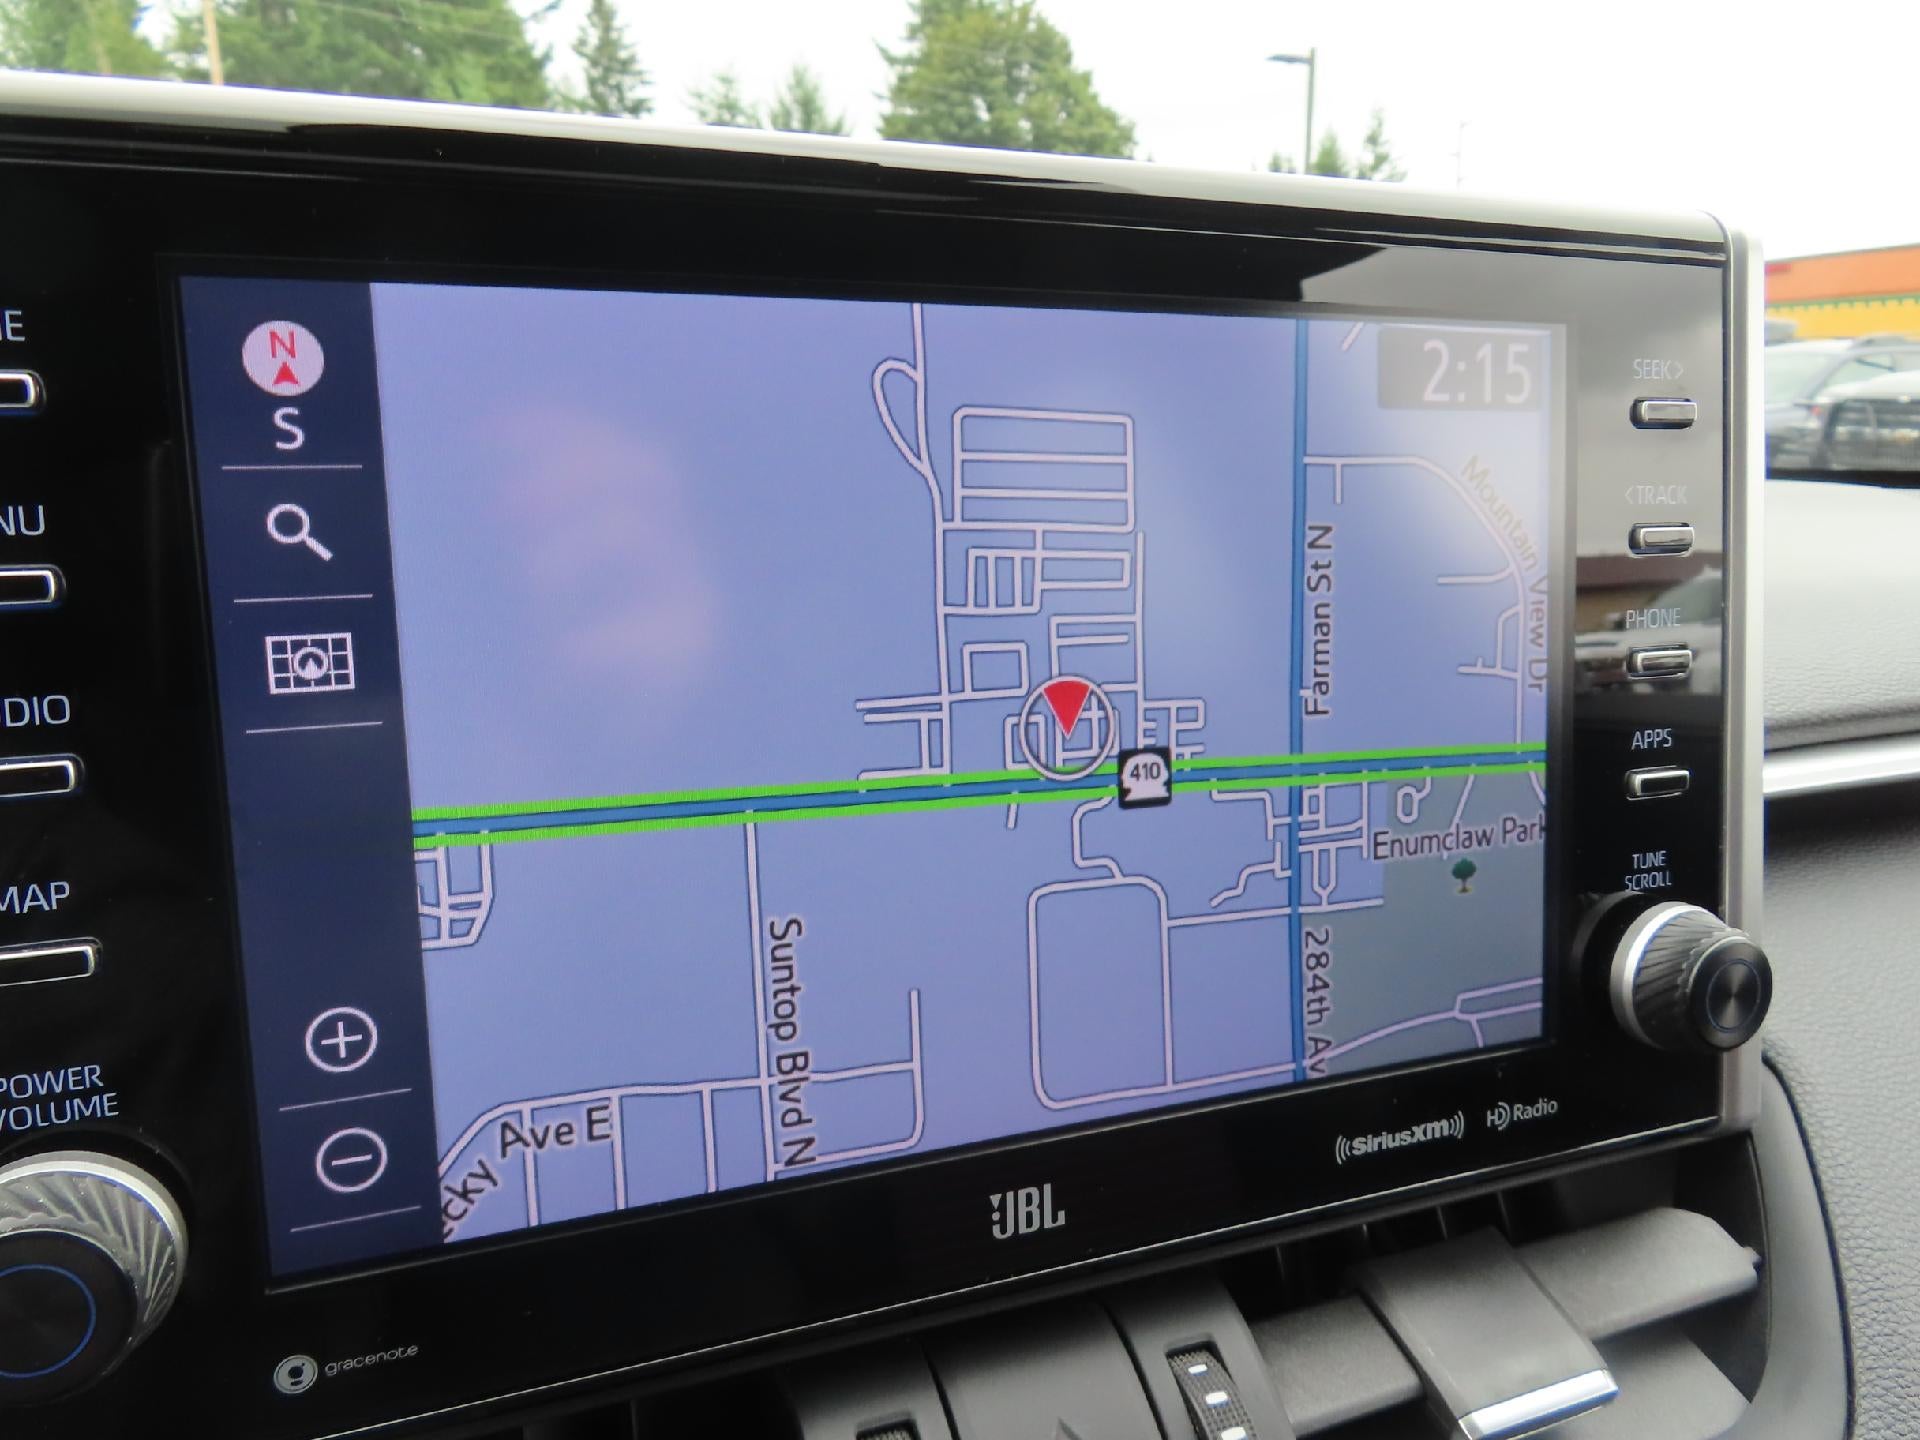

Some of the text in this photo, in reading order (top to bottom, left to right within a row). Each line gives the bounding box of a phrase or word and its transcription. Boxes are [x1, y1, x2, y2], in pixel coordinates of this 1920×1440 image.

[0, 309, 26, 341] E
[269, 331, 297, 359] N
[1423, 340, 1532, 404] 2:15
[1633, 359, 1671, 379] SEEK
[272, 406, 304, 450] S
[1636, 485, 1688, 504] TRACK
[1462, 455, 1548, 693] Mountain View Dr
[1304, 525, 1333, 717] Farman St N
[1625, 607, 1681, 629] PHONE
[0, 695, 71, 727] DIO
[1631, 727, 1673, 750] APPS
[1130, 761, 1161, 782] 410
[1373, 812, 1547, 861] Enumclaw Park
[1632, 850, 1666, 870] TUNE
[1624, 869, 1672, 892] SCROLL
[0, 881, 70, 914] MAP
[1304, 927, 1333, 1074] 284th Av
[767, 918, 816, 1167] Suntop Blvd N
[1513, 1098, 1558, 1121] Radio
[499, 1121, 574, 1158] Ave
[586, 1104, 610, 1142] E
[989, 1182, 1066, 1240] JBL
[324, 1344, 419, 1376] gracenote
